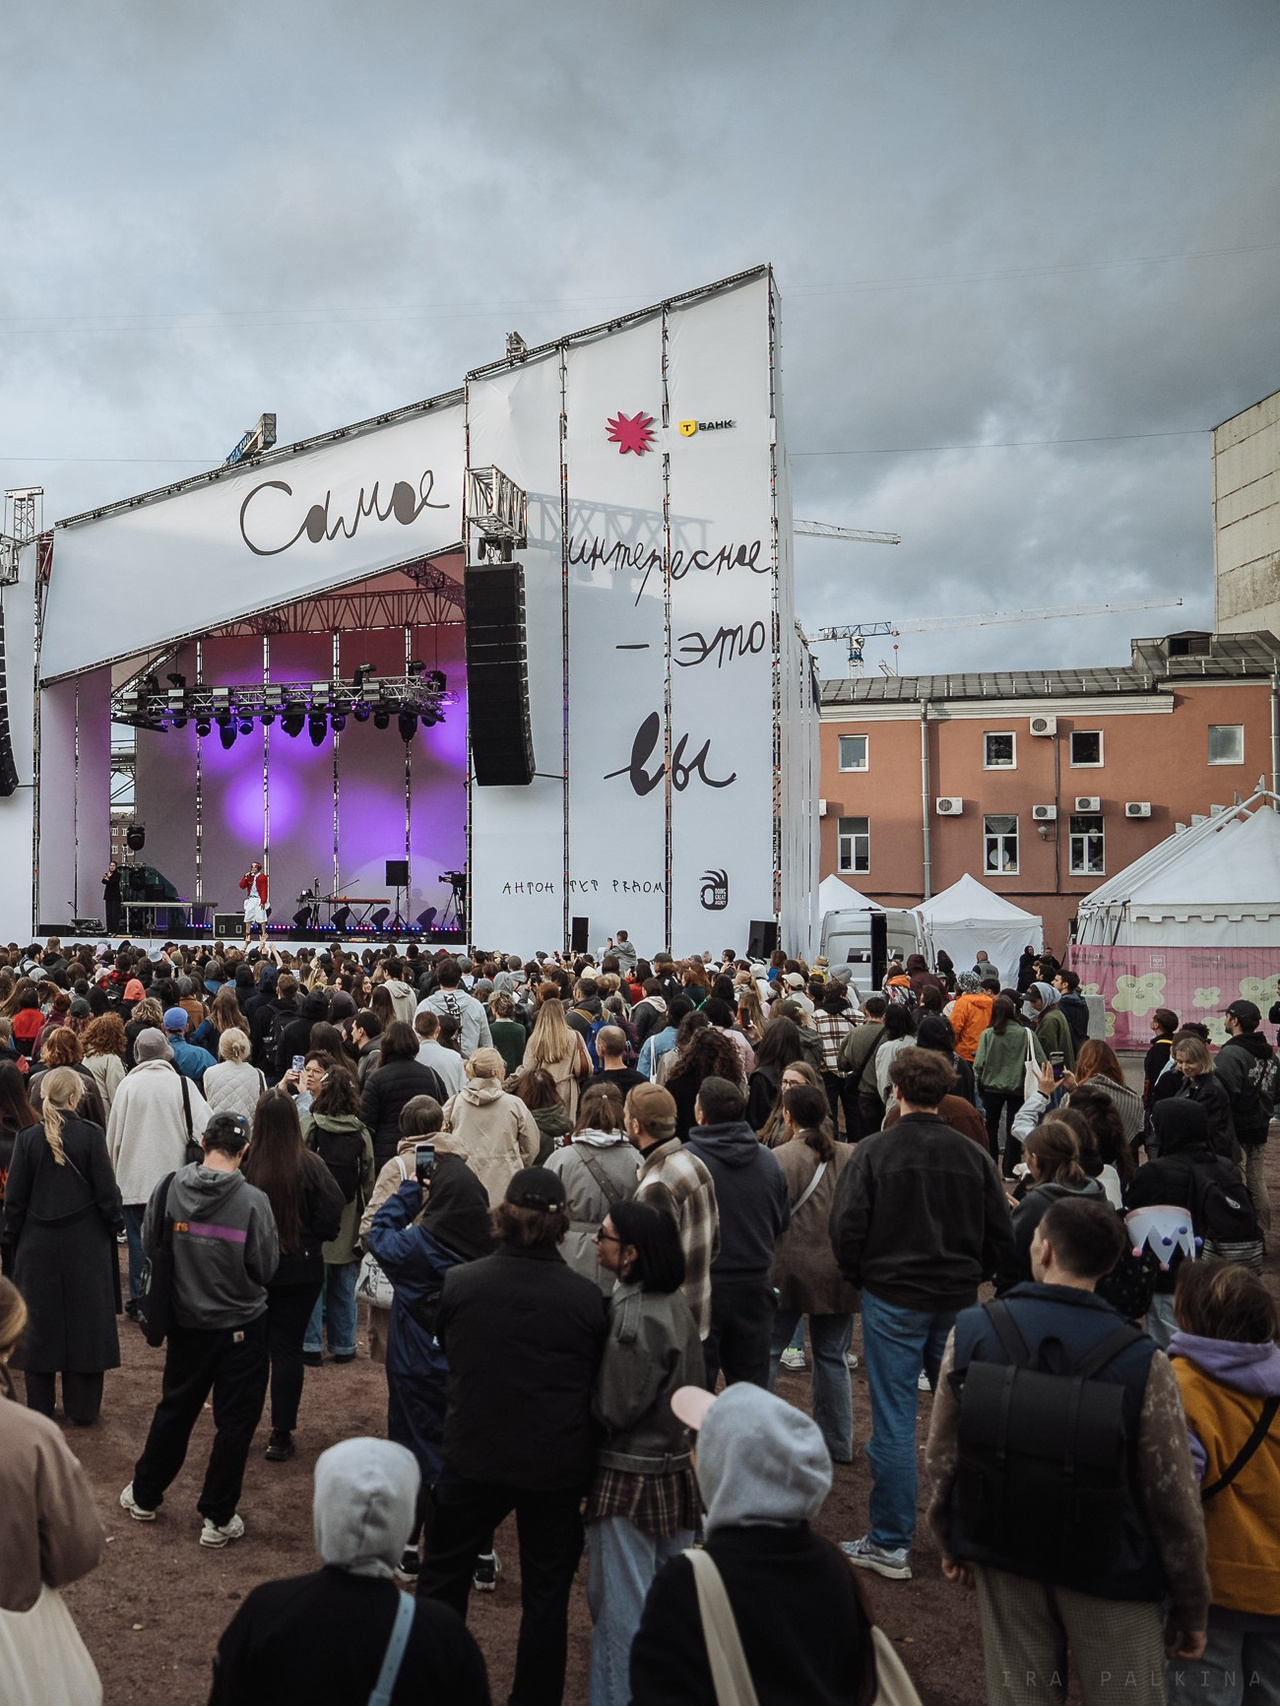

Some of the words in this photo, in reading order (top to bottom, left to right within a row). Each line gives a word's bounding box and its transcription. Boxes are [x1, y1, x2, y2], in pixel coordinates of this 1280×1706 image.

[699, 420, 733, 431] БАНК
[239, 469, 450, 556] Самое
[673, 621, 766, 669] это
